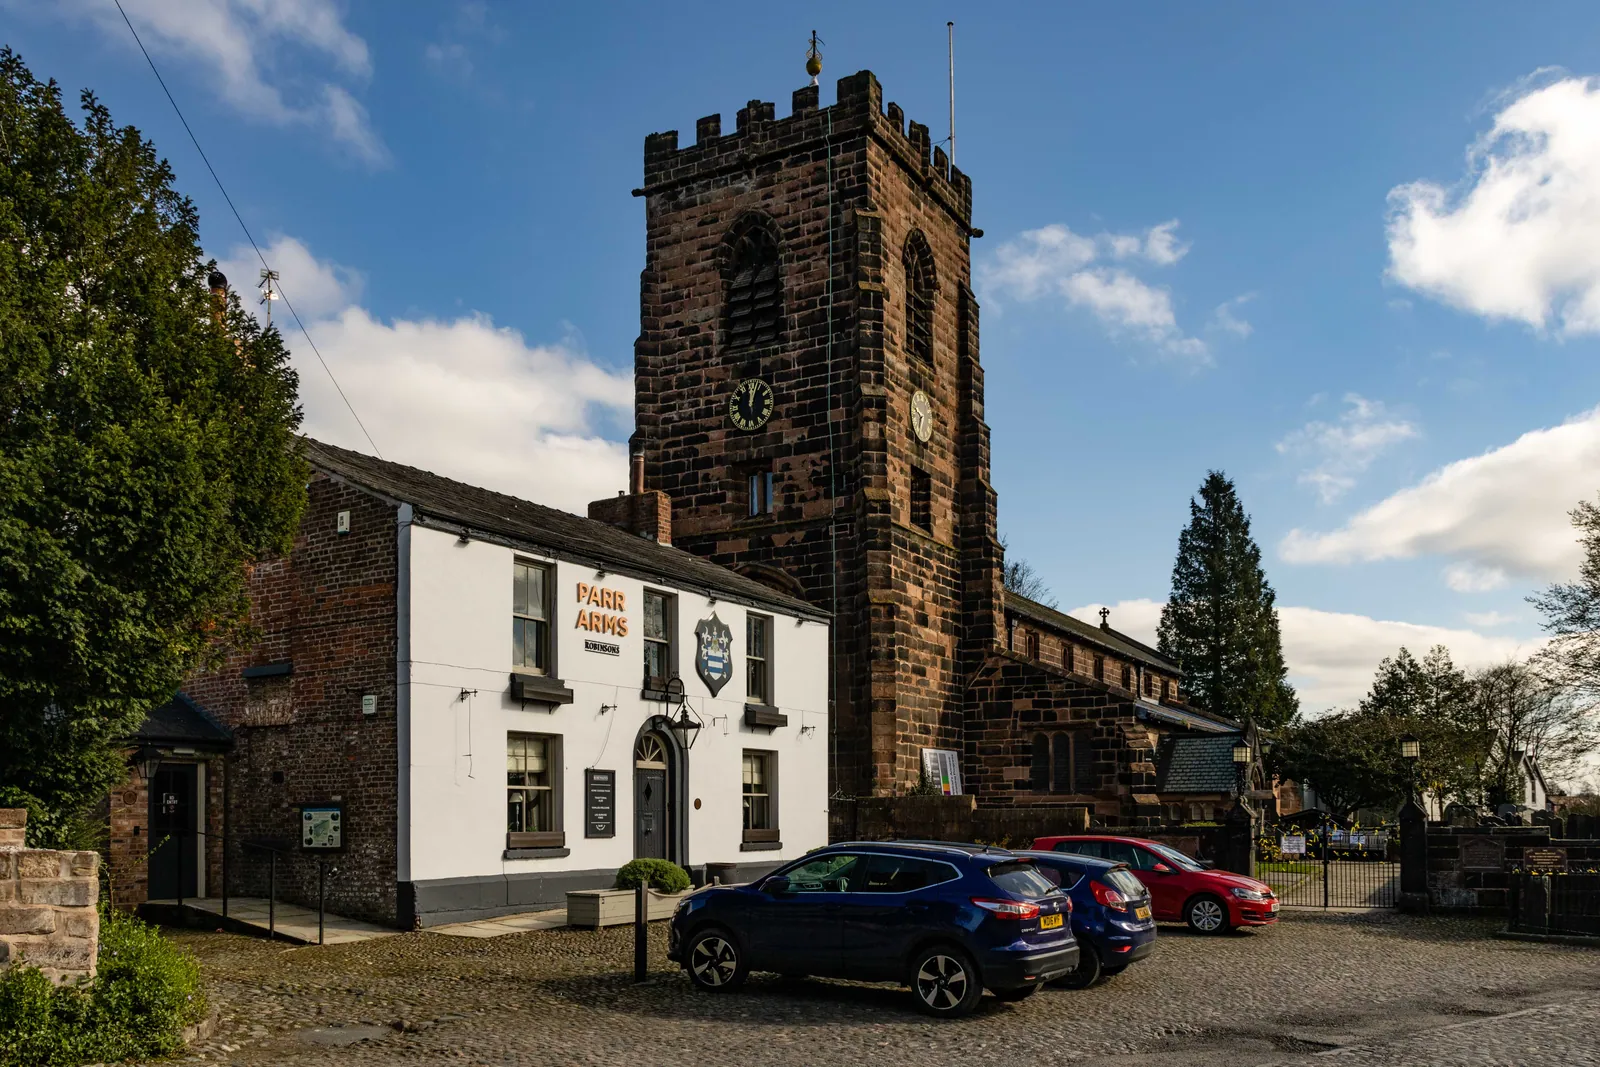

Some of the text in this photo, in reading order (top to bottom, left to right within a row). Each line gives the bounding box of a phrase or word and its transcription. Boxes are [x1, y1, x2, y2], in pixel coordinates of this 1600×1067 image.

[576, 582, 625, 612] PARR
[574, 608, 629, 637] ARMS
[584, 641, 620, 654] ROBINSONS
